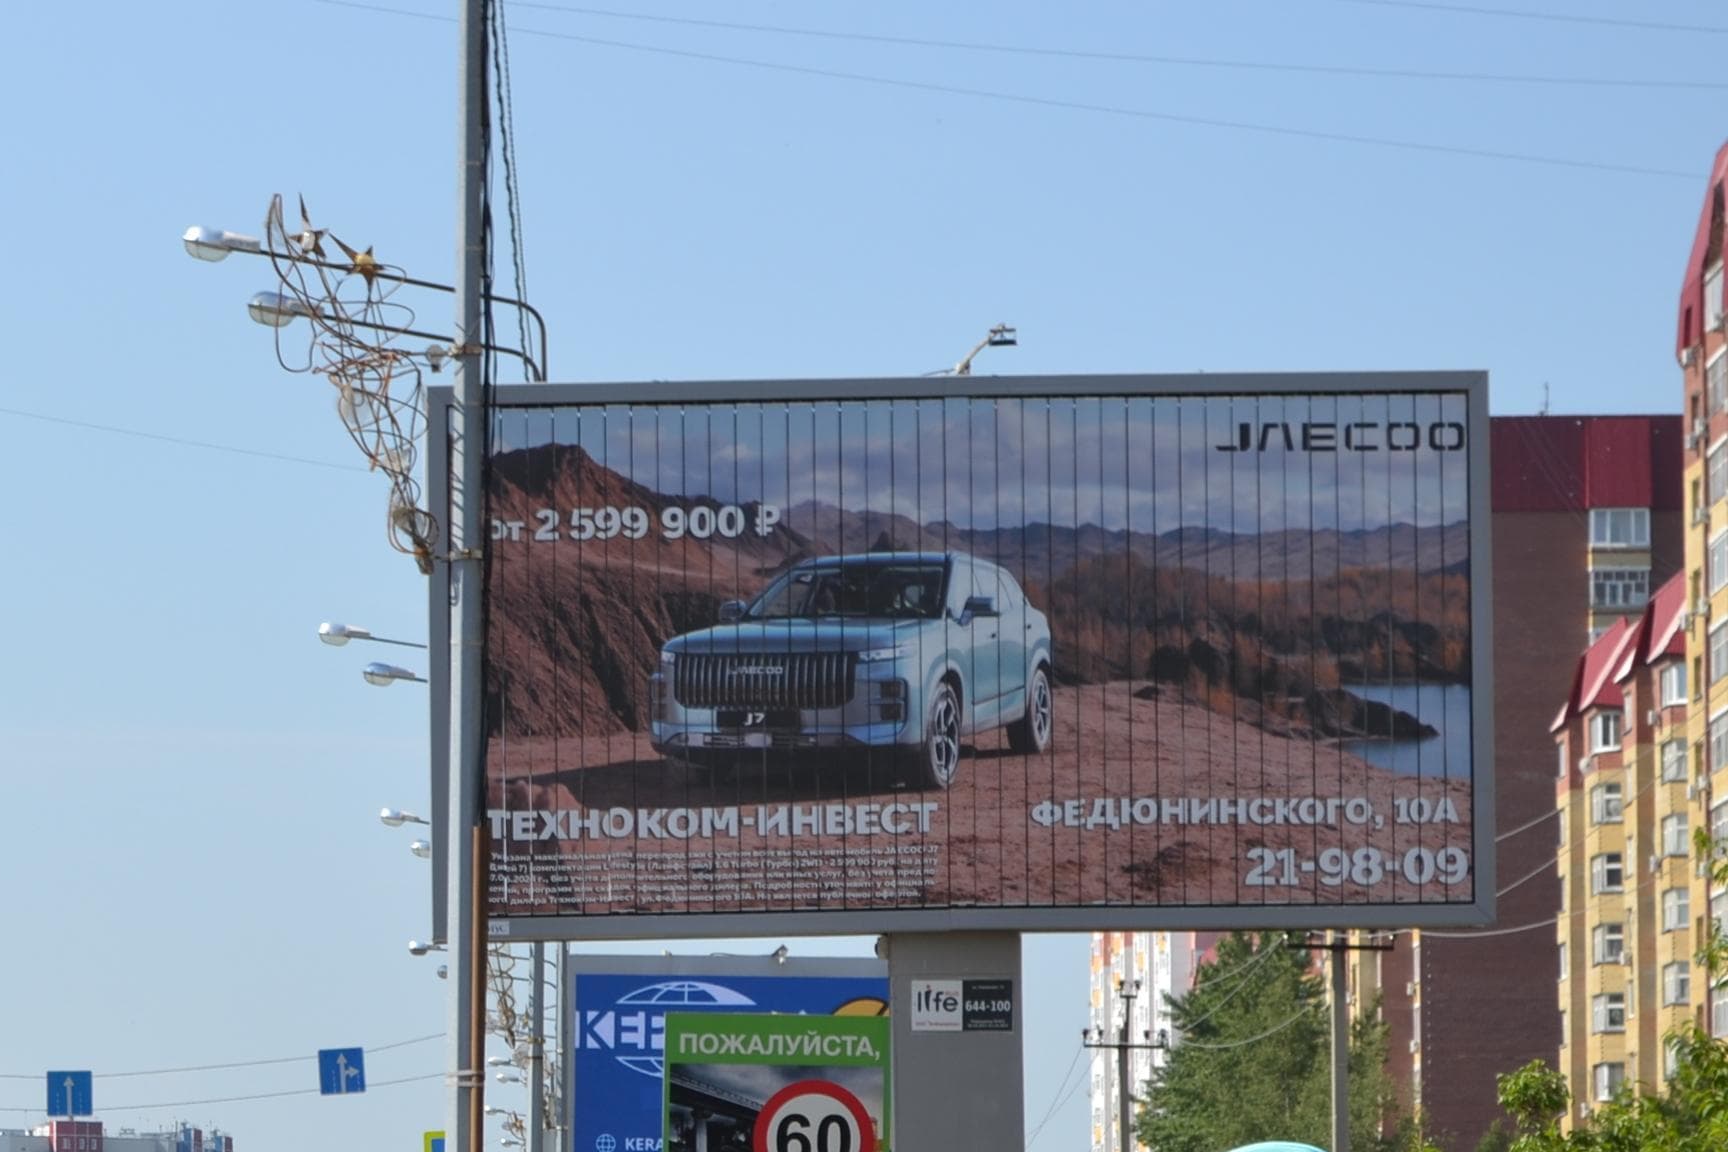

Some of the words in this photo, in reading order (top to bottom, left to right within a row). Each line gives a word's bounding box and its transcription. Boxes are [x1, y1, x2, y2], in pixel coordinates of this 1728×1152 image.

[1216, 422, 1467, 452] JAECOO
[490, 516, 523, 542] от
[535, 508, 560, 541] 2
[571, 507, 649, 541] 599
[661, 505, 745, 538] 900
[742, 711, 766, 727] J7
[487, 801, 939, 841] ТЕХНОКОМ-ИНВЕСТ
[1030, 798, 1385, 829] ФЕДЮНИНСКОГО,
[1393, 796, 1460, 823] 10А
[1245, 846, 1469, 886] 21-98-09
[916, 984, 959, 1013] life
[964, 1000, 1012, 1012] 644-100
[679, 1029, 881, 1061] ПОЖАЛУЙСТА,
